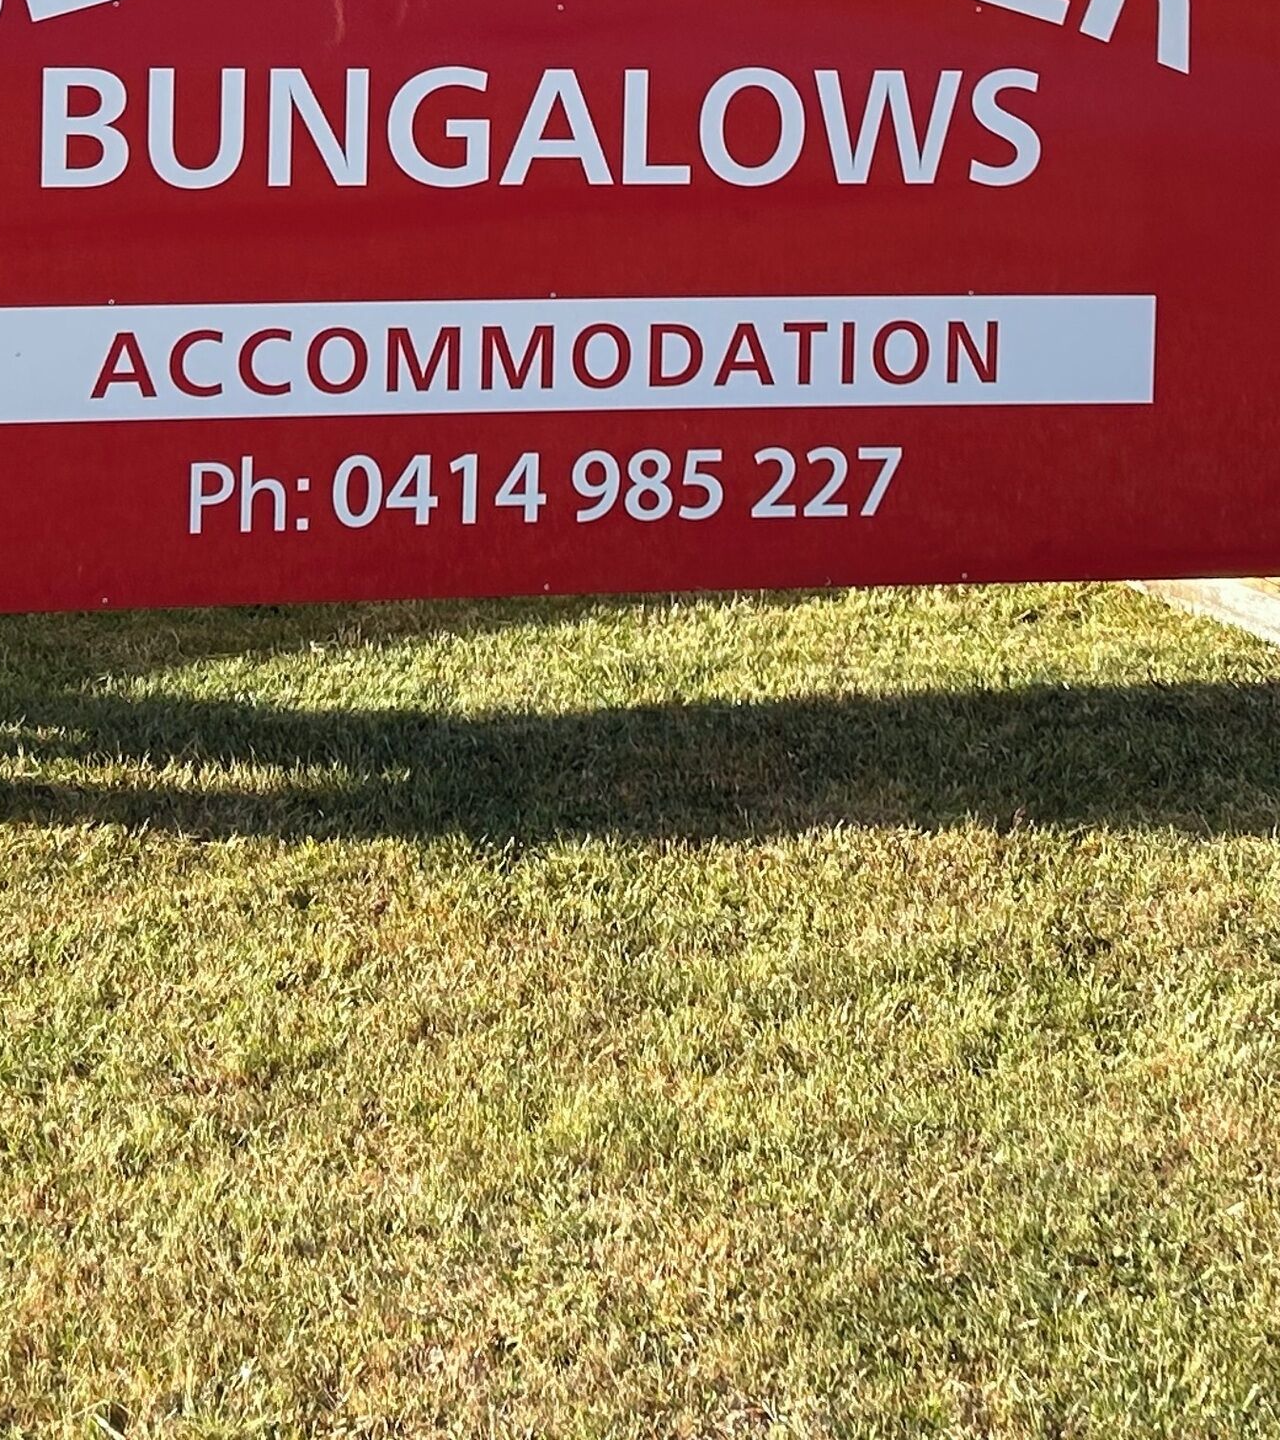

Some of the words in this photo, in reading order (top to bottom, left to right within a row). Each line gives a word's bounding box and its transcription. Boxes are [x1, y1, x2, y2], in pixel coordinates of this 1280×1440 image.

[40, 66, 1042, 190] BUNGALOWS
[90, 319, 1000, 400] ACCOMMODATION
[189, 454, 311, 535] Ph:
[331, 452, 547, 528] 0414
[570, 449, 725, 524] 985
[750, 445, 904, 519] 227
